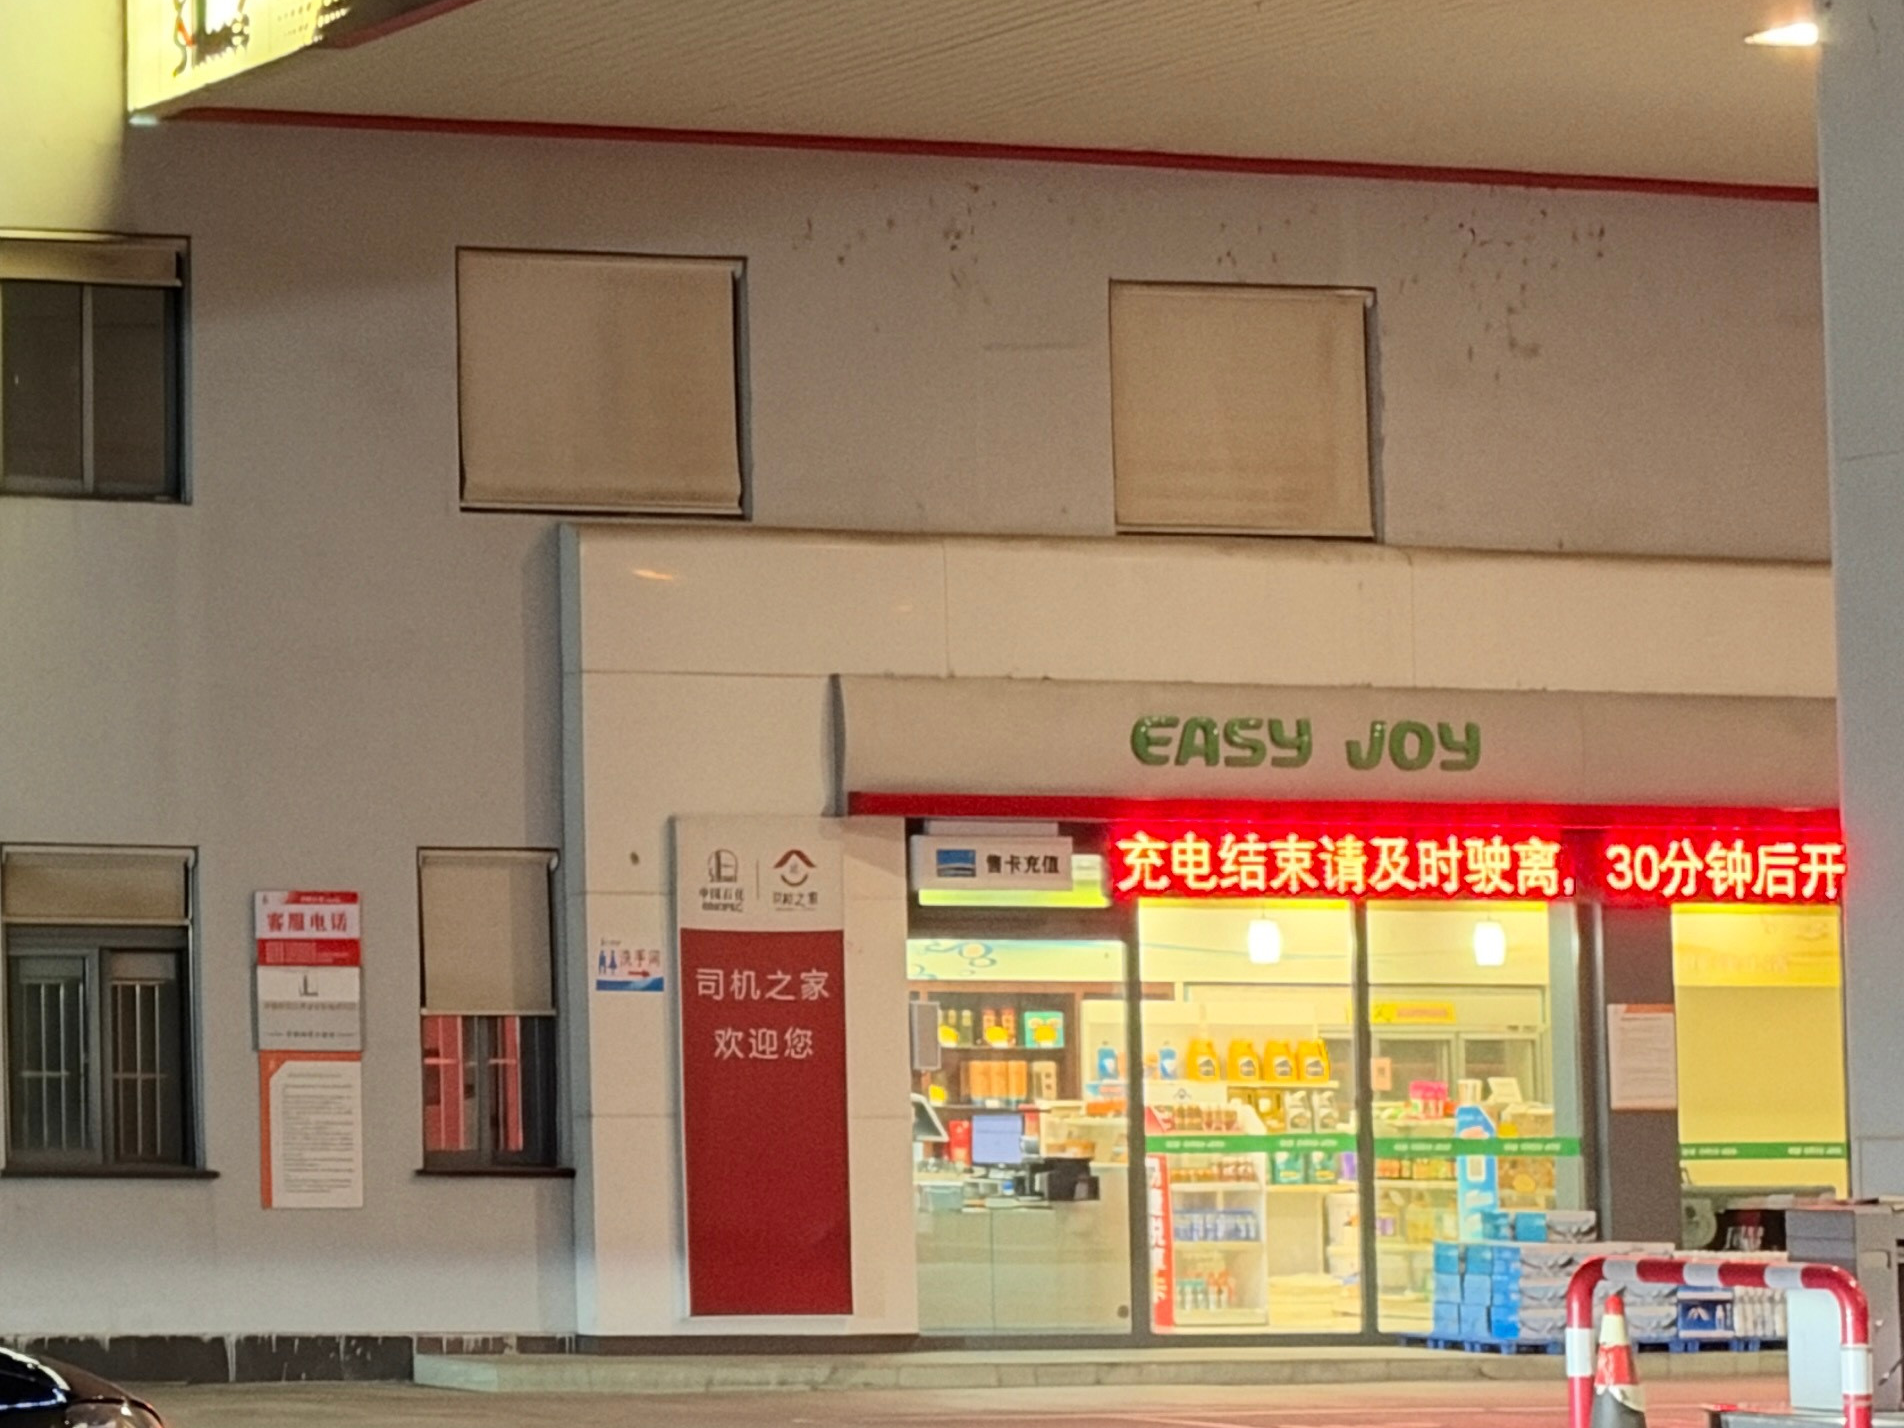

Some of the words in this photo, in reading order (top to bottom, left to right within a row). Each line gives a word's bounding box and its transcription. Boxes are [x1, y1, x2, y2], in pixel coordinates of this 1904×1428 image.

[1130, 716, 1312, 768] EASY
[1345, 720, 1481, 771] JOY
[986, 854, 1060, 874] 售卡充值
[1605, 837, 1846, 899] 30分钟后开
[267, 912, 348, 932] 客服电话
[695, 968, 830, 1001] 司机之家
[714, 1026, 814, 1060] 欢迎您
